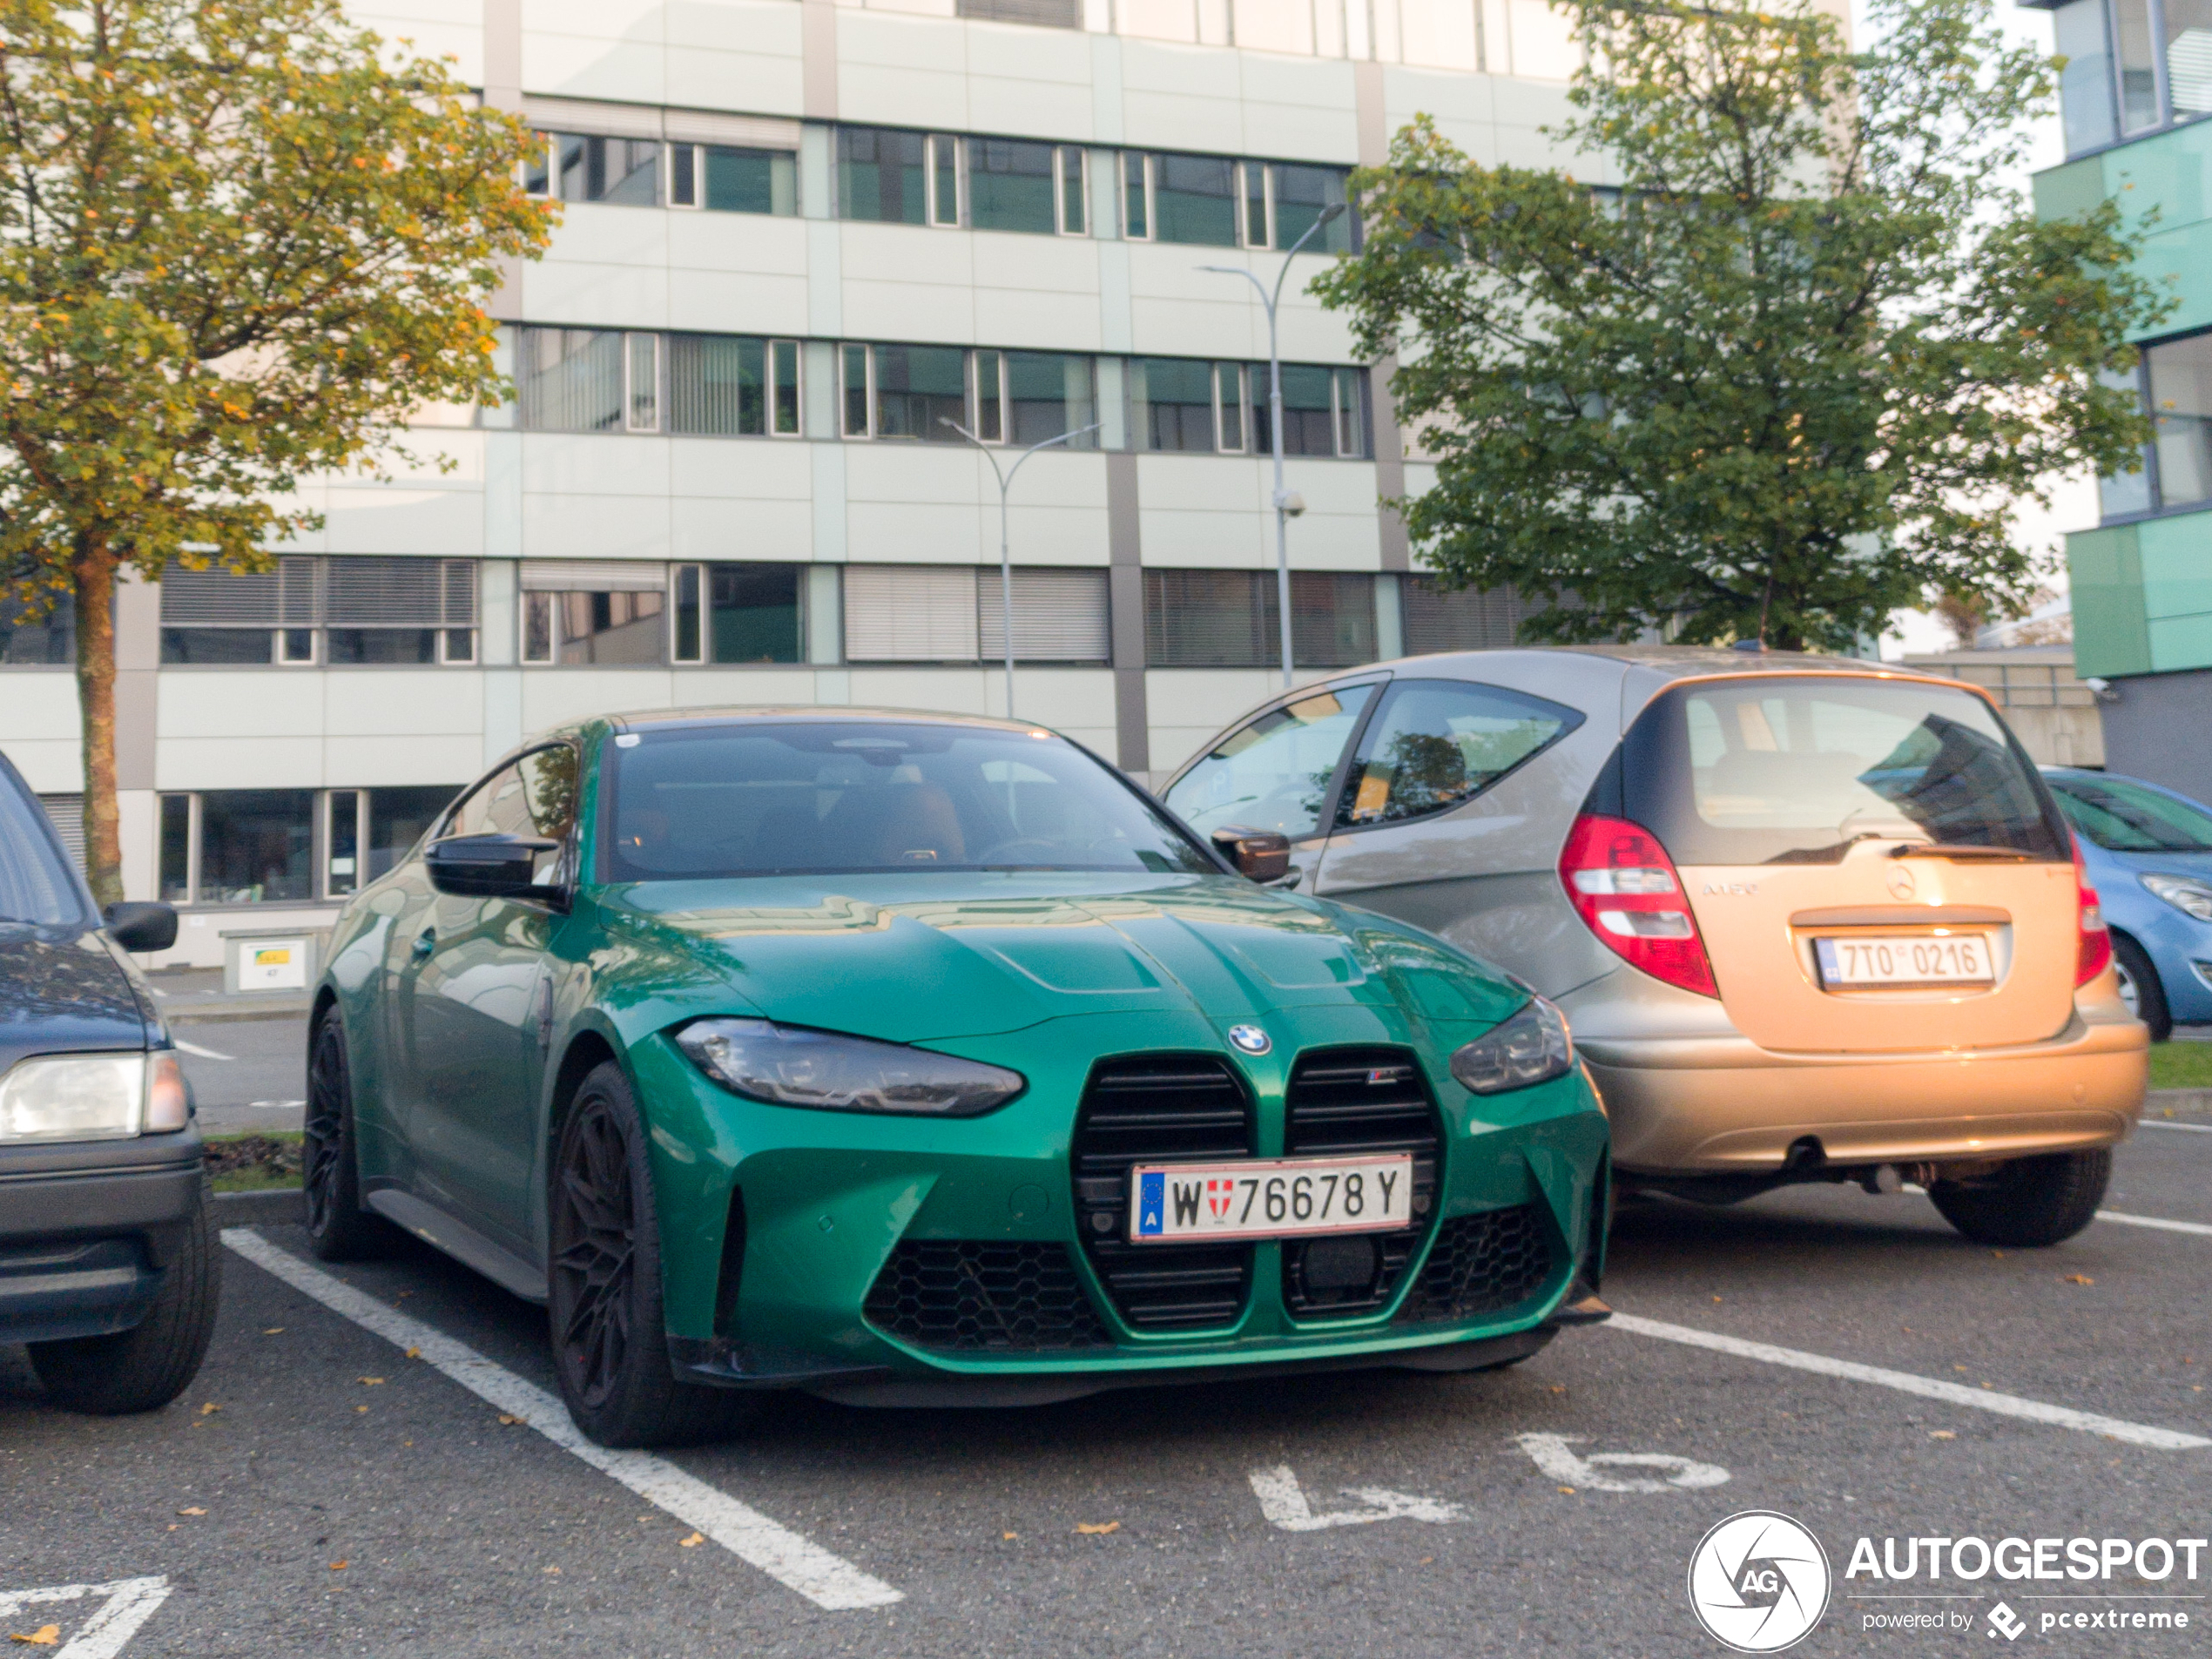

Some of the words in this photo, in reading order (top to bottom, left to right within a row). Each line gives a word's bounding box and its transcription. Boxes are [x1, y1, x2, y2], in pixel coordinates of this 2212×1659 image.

[1912, 944, 1978, 975] 0216
[1824, 968, 1840, 978] CZ
[1173, 1182, 1201, 1227] W
[1238, 1173, 1364, 1224] 76678
[1378, 1170, 1397, 1215] Y
[1145, 1212, 1157, 1226] A
